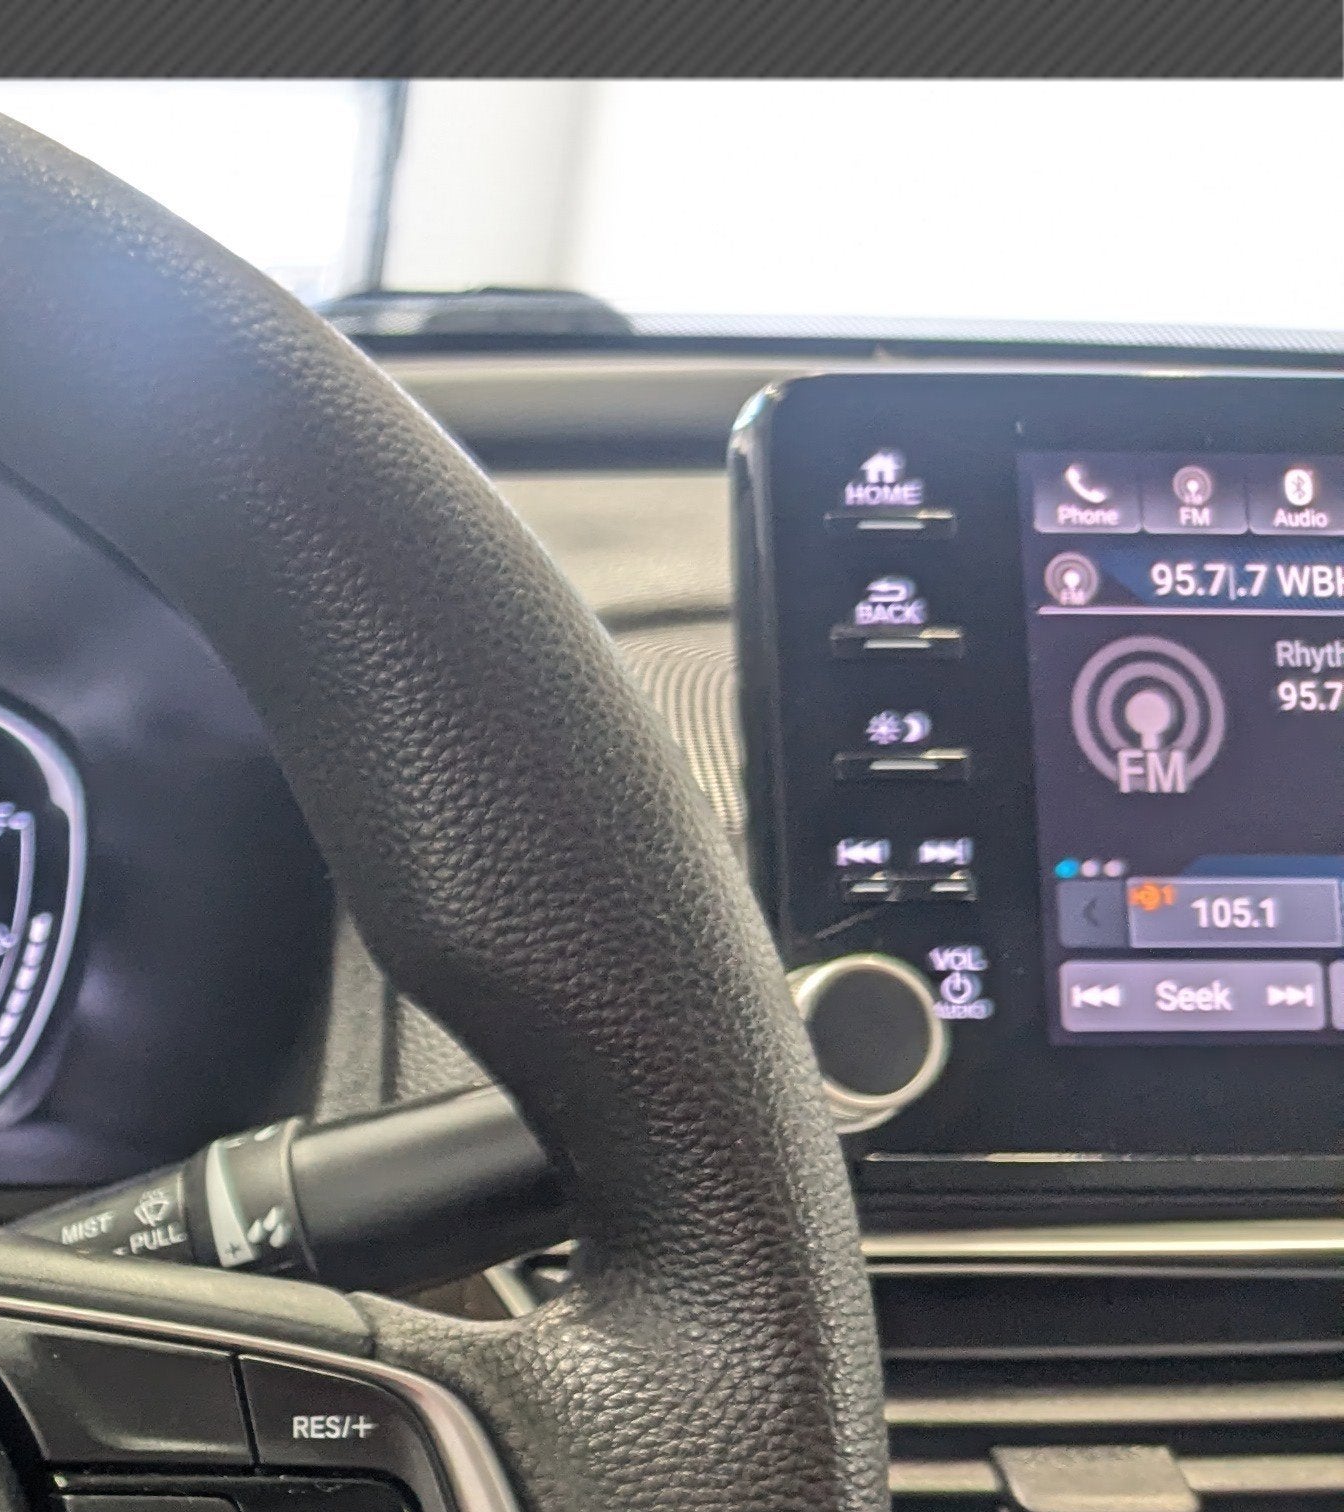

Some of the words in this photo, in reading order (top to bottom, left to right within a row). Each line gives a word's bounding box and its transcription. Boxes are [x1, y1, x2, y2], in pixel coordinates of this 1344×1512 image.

[845, 482, 922, 506] HOME
[1057, 504, 1119, 527] Phone
[1179, 508, 1211, 527] FM
[1273, 508, 1328, 528] Audio
[854, 601, 926, 626] BACK
[1117, 749, 1189, 793] FM
[1191, 897, 1277, 928] 105.1
[928, 946, 988, 971] VOL
[1156, 979, 1234, 1011] Seek
[61, 1209, 113, 1245] MIST
[130, 1228, 187, 1256] PULL
